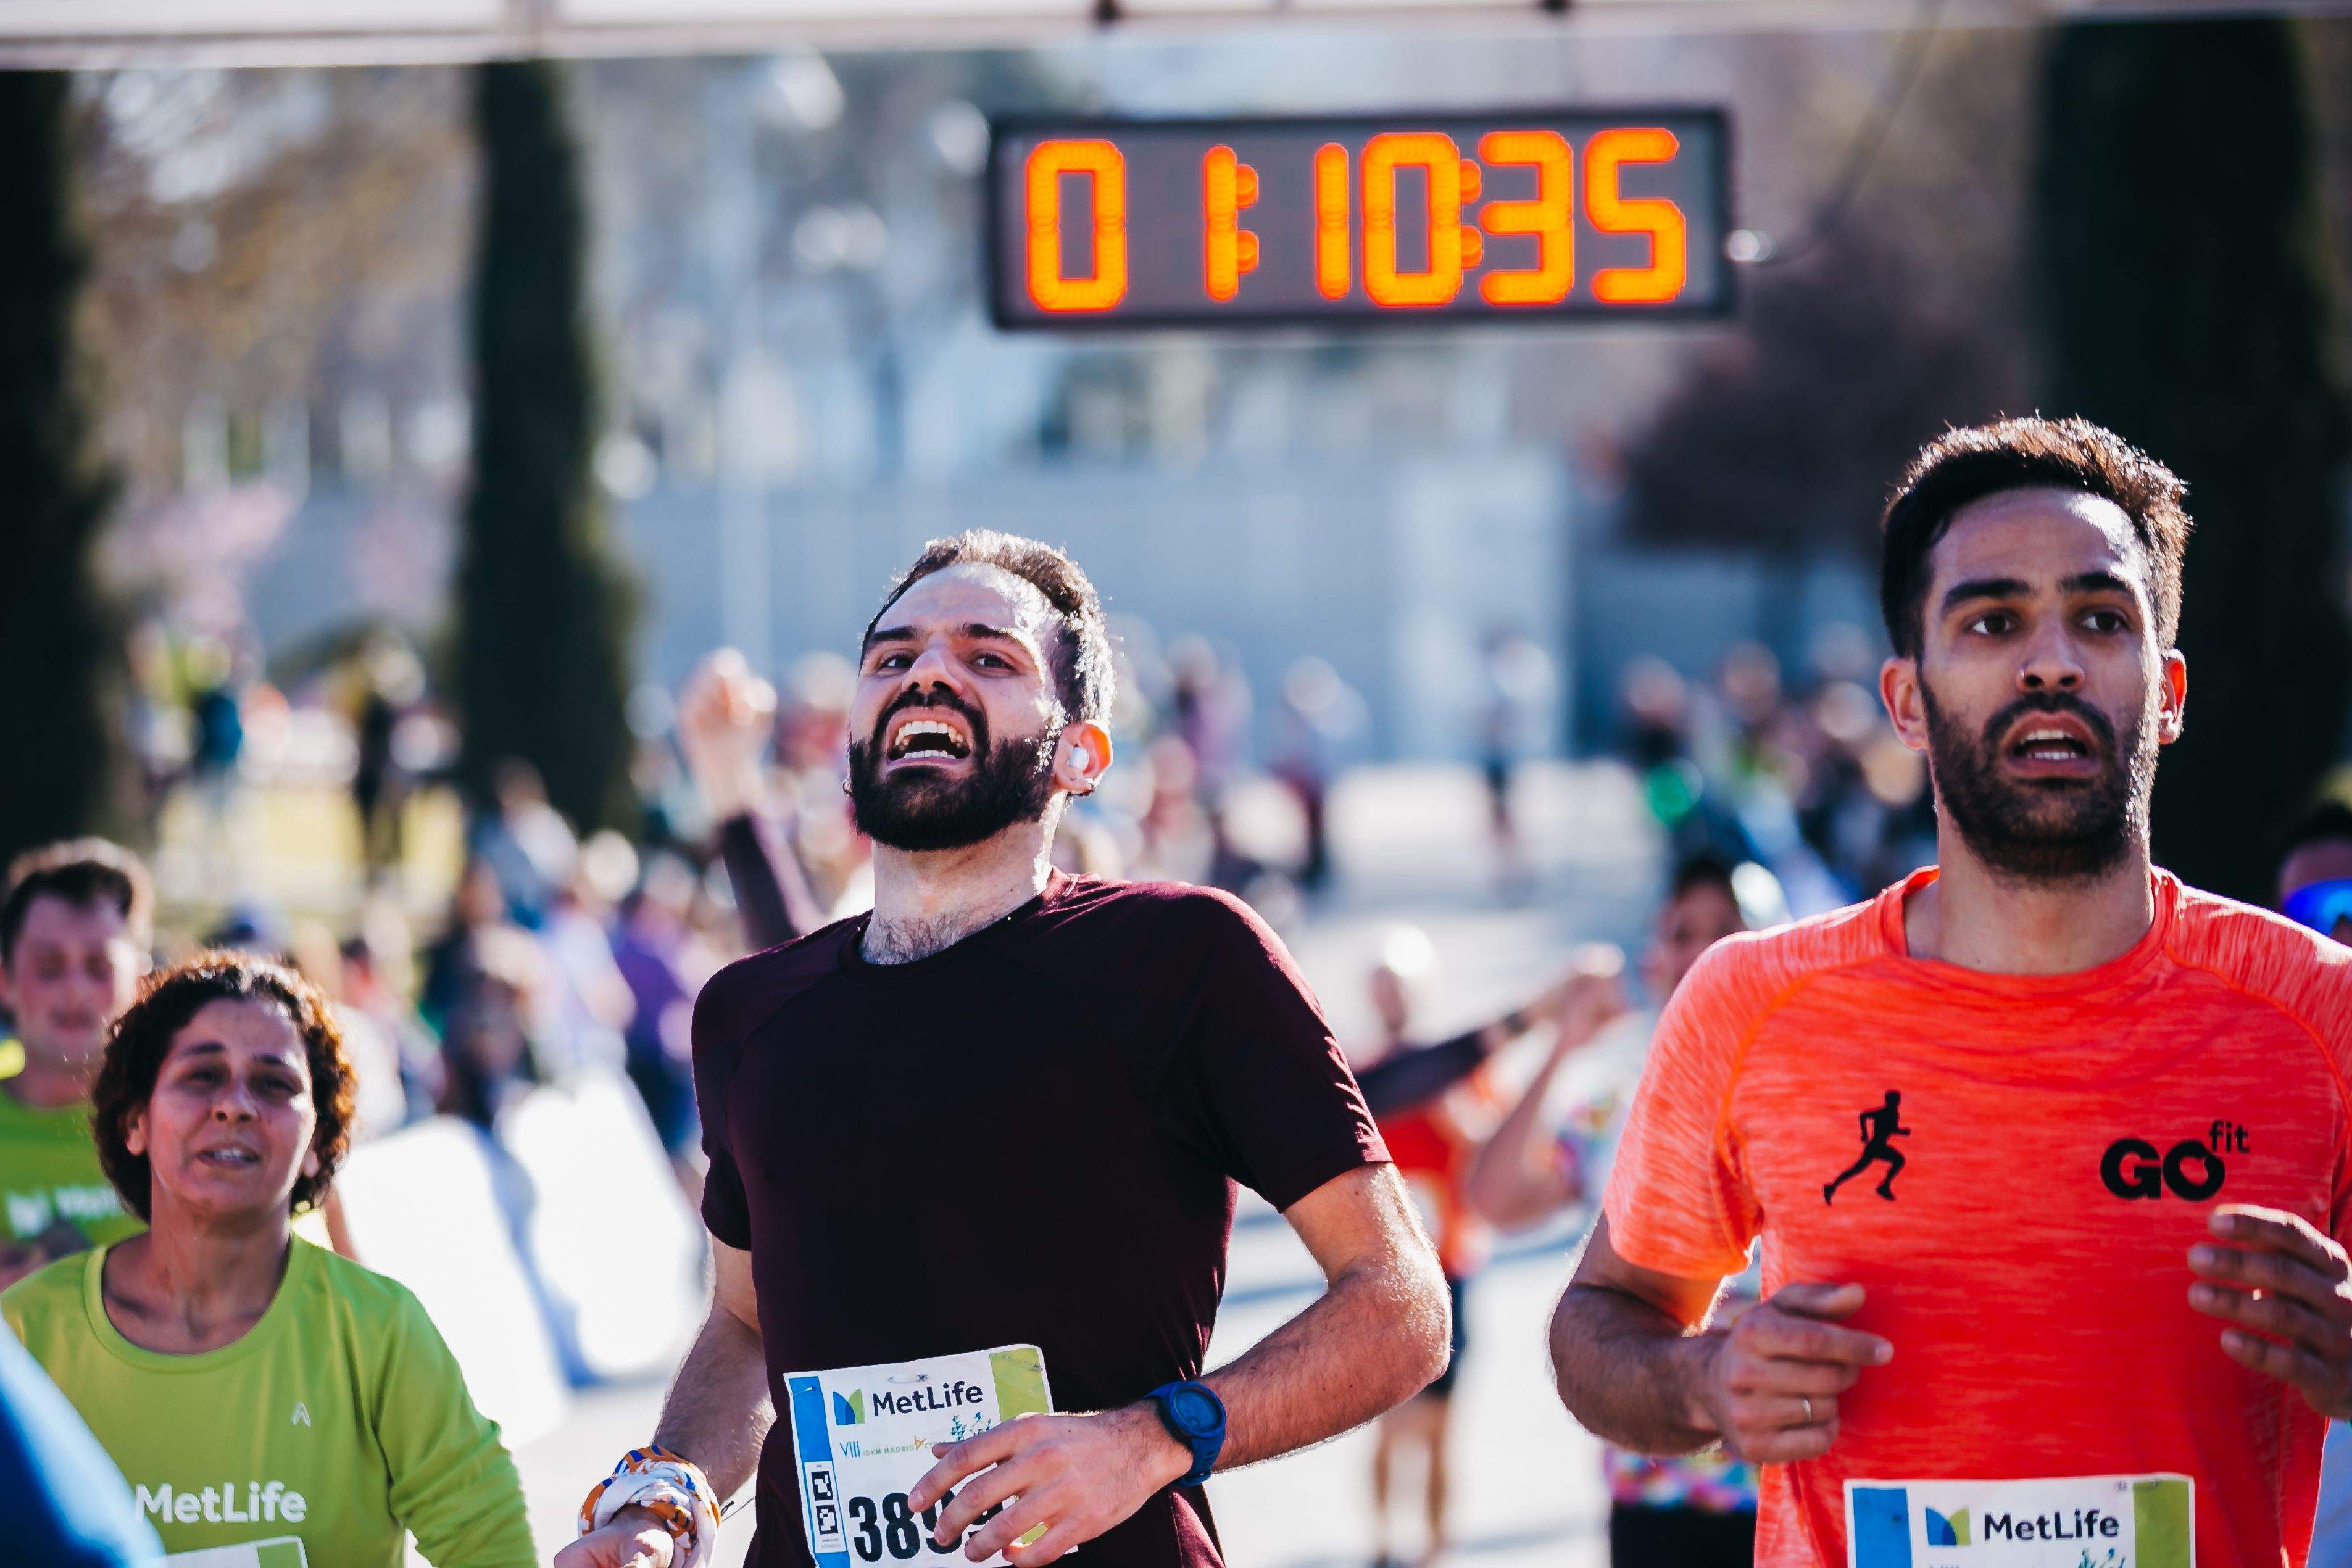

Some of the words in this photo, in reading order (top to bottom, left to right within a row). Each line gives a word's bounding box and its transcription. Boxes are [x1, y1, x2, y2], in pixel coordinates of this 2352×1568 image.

[2100, 1138, 2225, 1201] GO
[2209, 1119, 2250, 1153] fit
[872, 1380, 983, 1417] MetLife
[839, 1440, 861, 1458] VIII
[884, 1445, 915, 1454] MADRID
[135, 1480, 307, 1523] MetLife
[1984, 1508, 2119, 1540] MetLife
